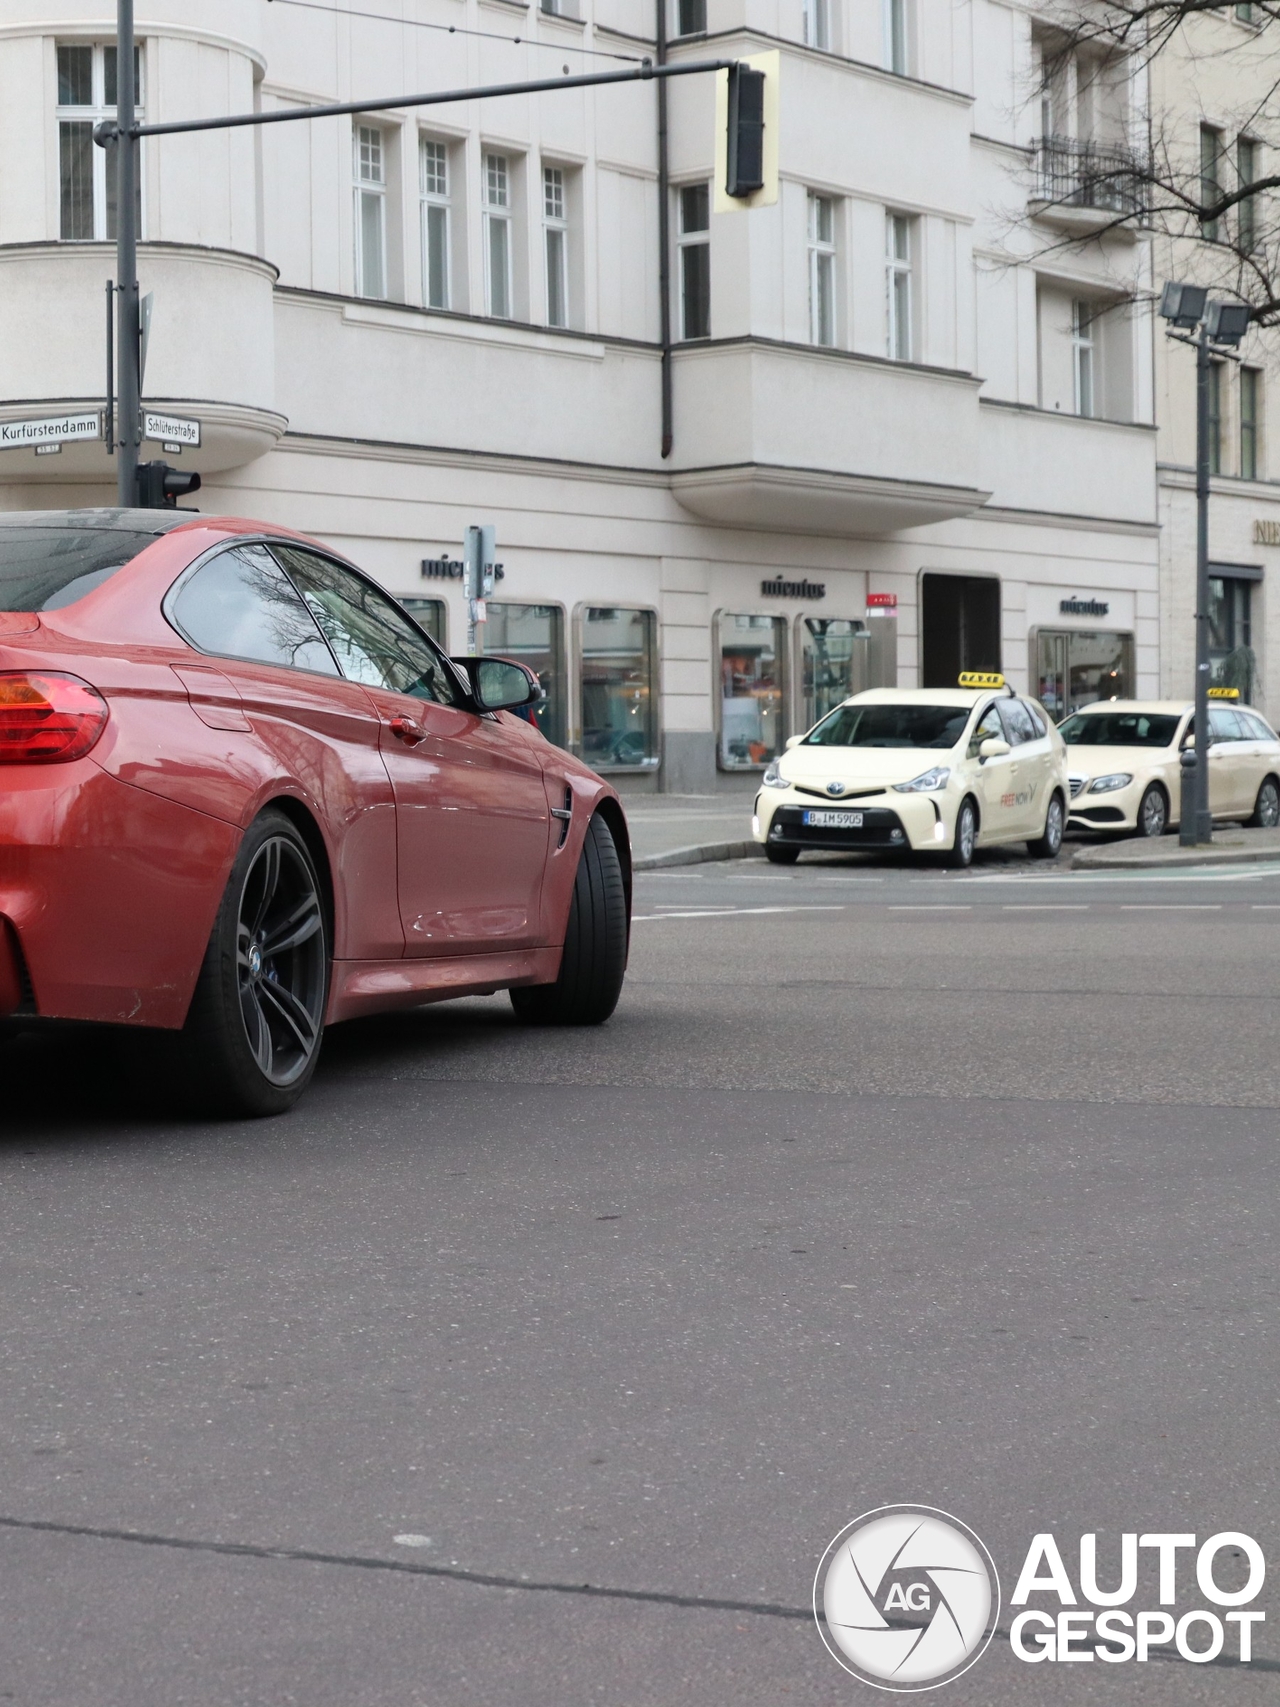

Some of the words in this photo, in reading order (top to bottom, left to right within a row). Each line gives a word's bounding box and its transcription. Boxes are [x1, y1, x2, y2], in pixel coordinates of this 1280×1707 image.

[1, 419, 97, 441] Kurfürstendamm
[147, 417, 196, 440] Schlüterstraße
[761, 574, 826, 598] mientus
[836, 813, 862, 825] 5905
